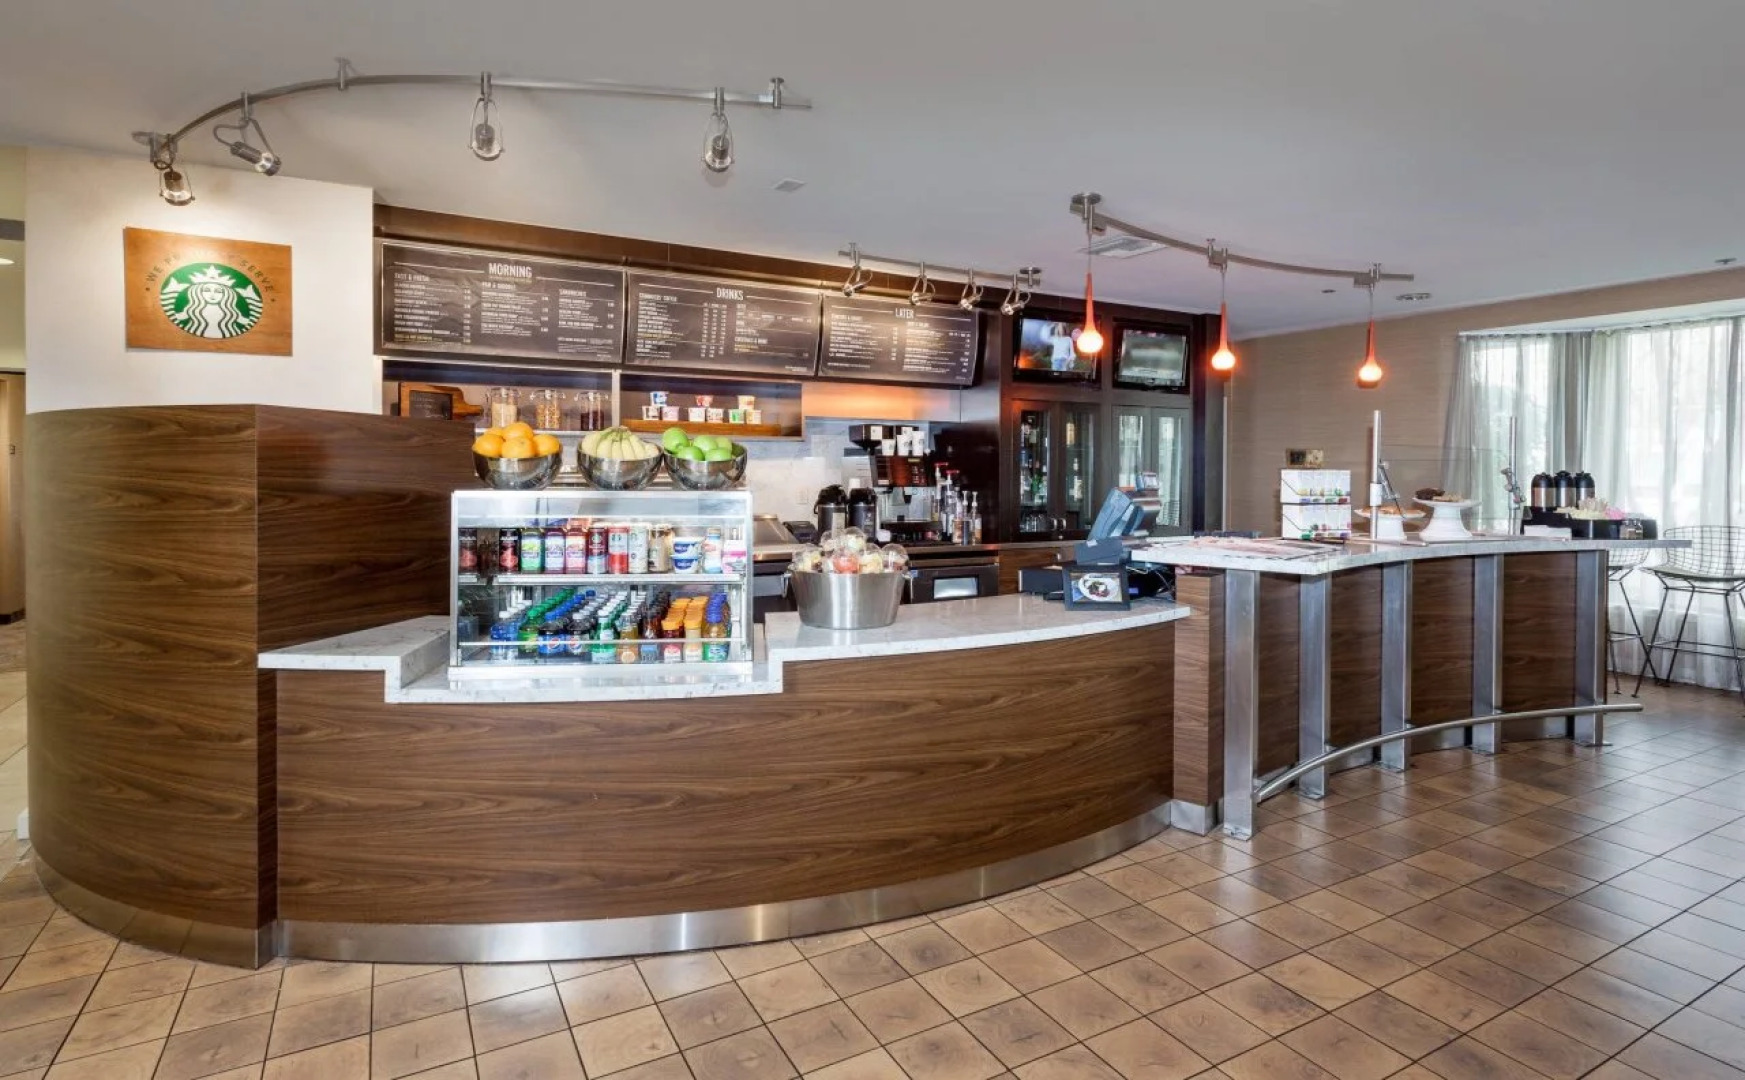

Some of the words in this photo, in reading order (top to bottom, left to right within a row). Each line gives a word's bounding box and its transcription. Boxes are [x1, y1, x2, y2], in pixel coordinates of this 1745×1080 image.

[146, 265, 162, 282] WE
[239, 259, 274, 292] SERVE
[488, 262, 533, 278] MORNING
[716, 287, 744, 301] DRINKS
[895, 307, 914, 319] LATER
